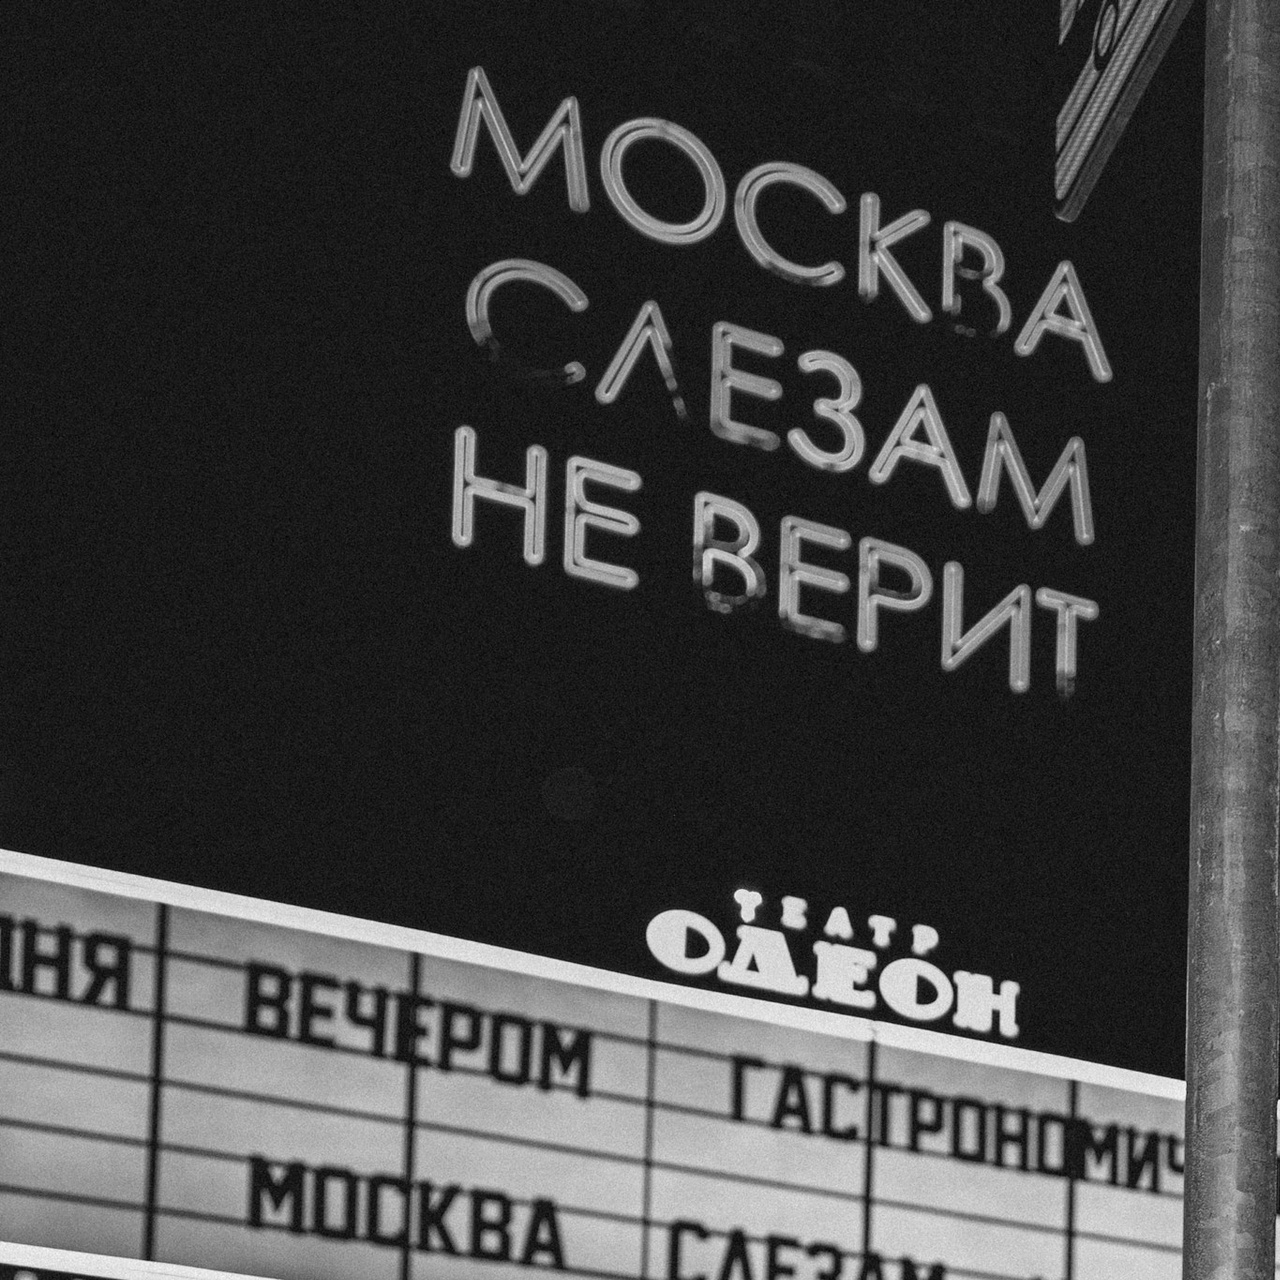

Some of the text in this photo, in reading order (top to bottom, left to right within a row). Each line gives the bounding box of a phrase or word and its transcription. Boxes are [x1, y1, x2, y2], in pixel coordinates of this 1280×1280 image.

[450, 65, 1113, 383] МОСКВА
[465, 258, 1095, 546] СЛЕЗАМ
[452, 425, 1099, 696] НЕ ВЕРИТ
[645, 908, 1021, 1038] ОДЕОН
[733, 888, 940, 956] ТЕАТР
[244, 961, 594, 1098] ВЕЧЕРОМ
[250, 1154, 567, 1270] МОСКВА
